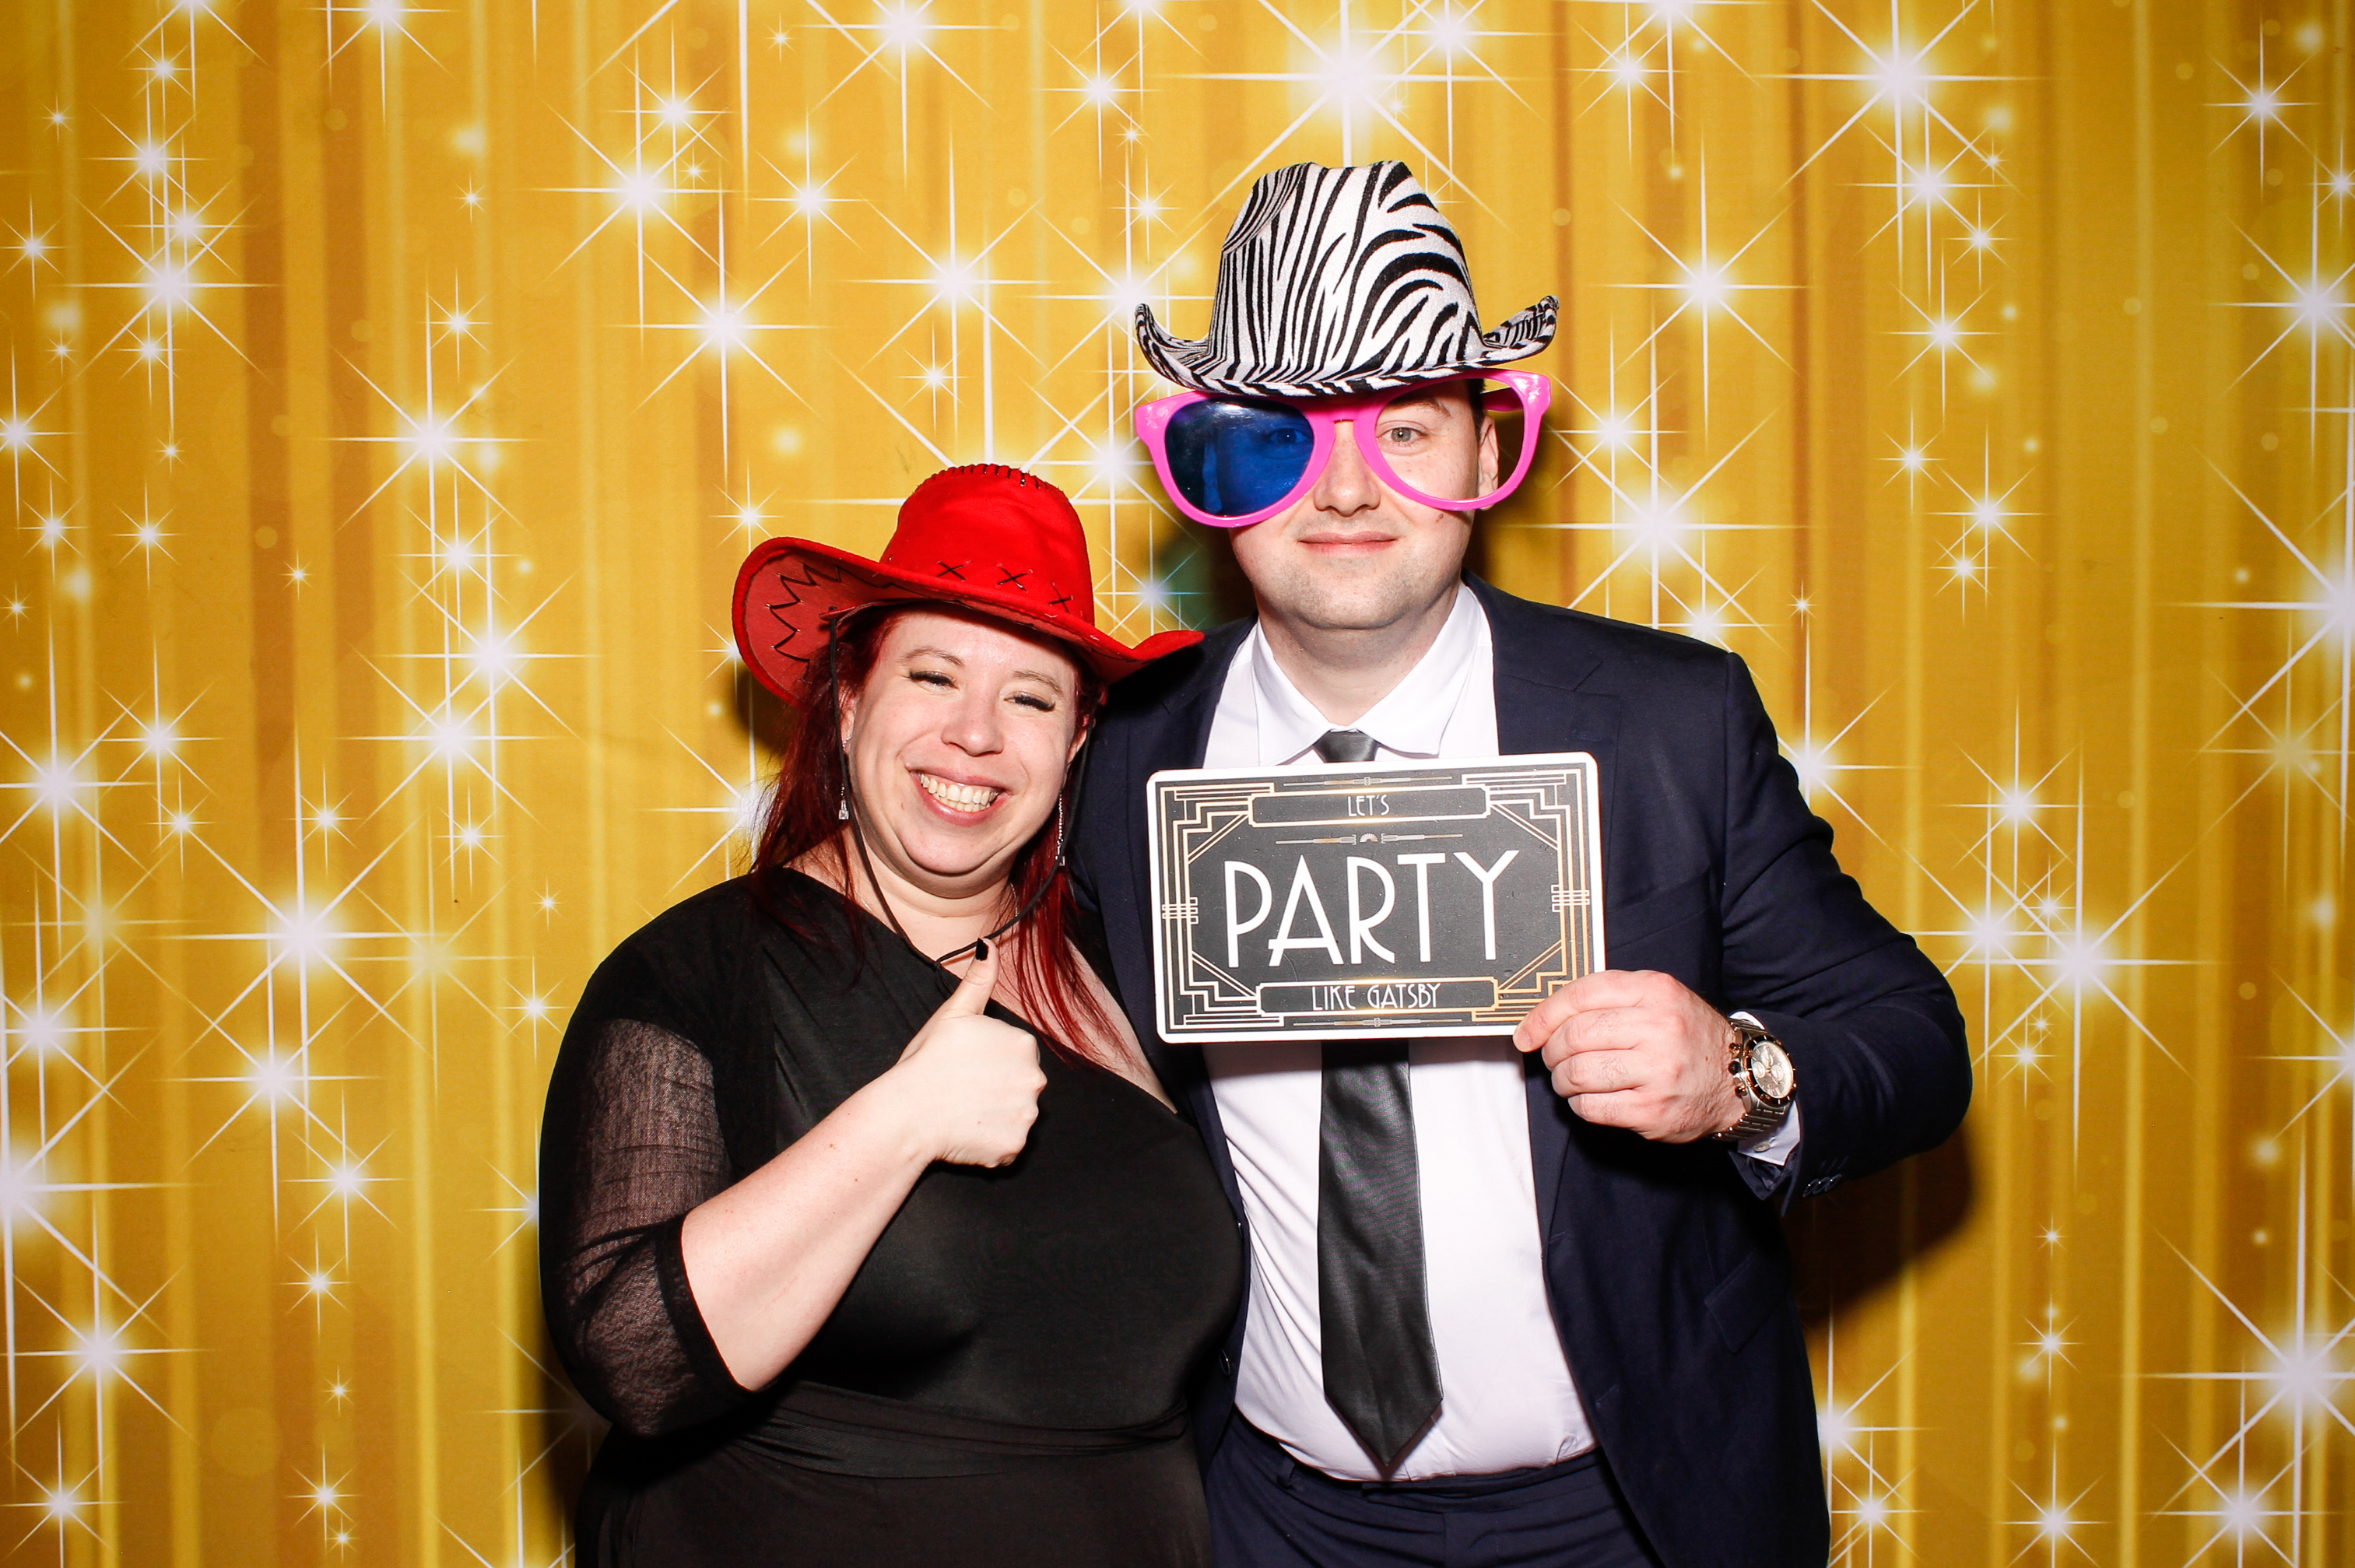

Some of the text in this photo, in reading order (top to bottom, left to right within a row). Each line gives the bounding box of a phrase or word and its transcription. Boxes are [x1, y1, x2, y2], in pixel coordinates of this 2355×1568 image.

[1347, 794, 1390, 817] LET'S
[1224, 850, 1520, 968] PARTY
[1312, 982, 1441, 1011] LIKE GATSBY
